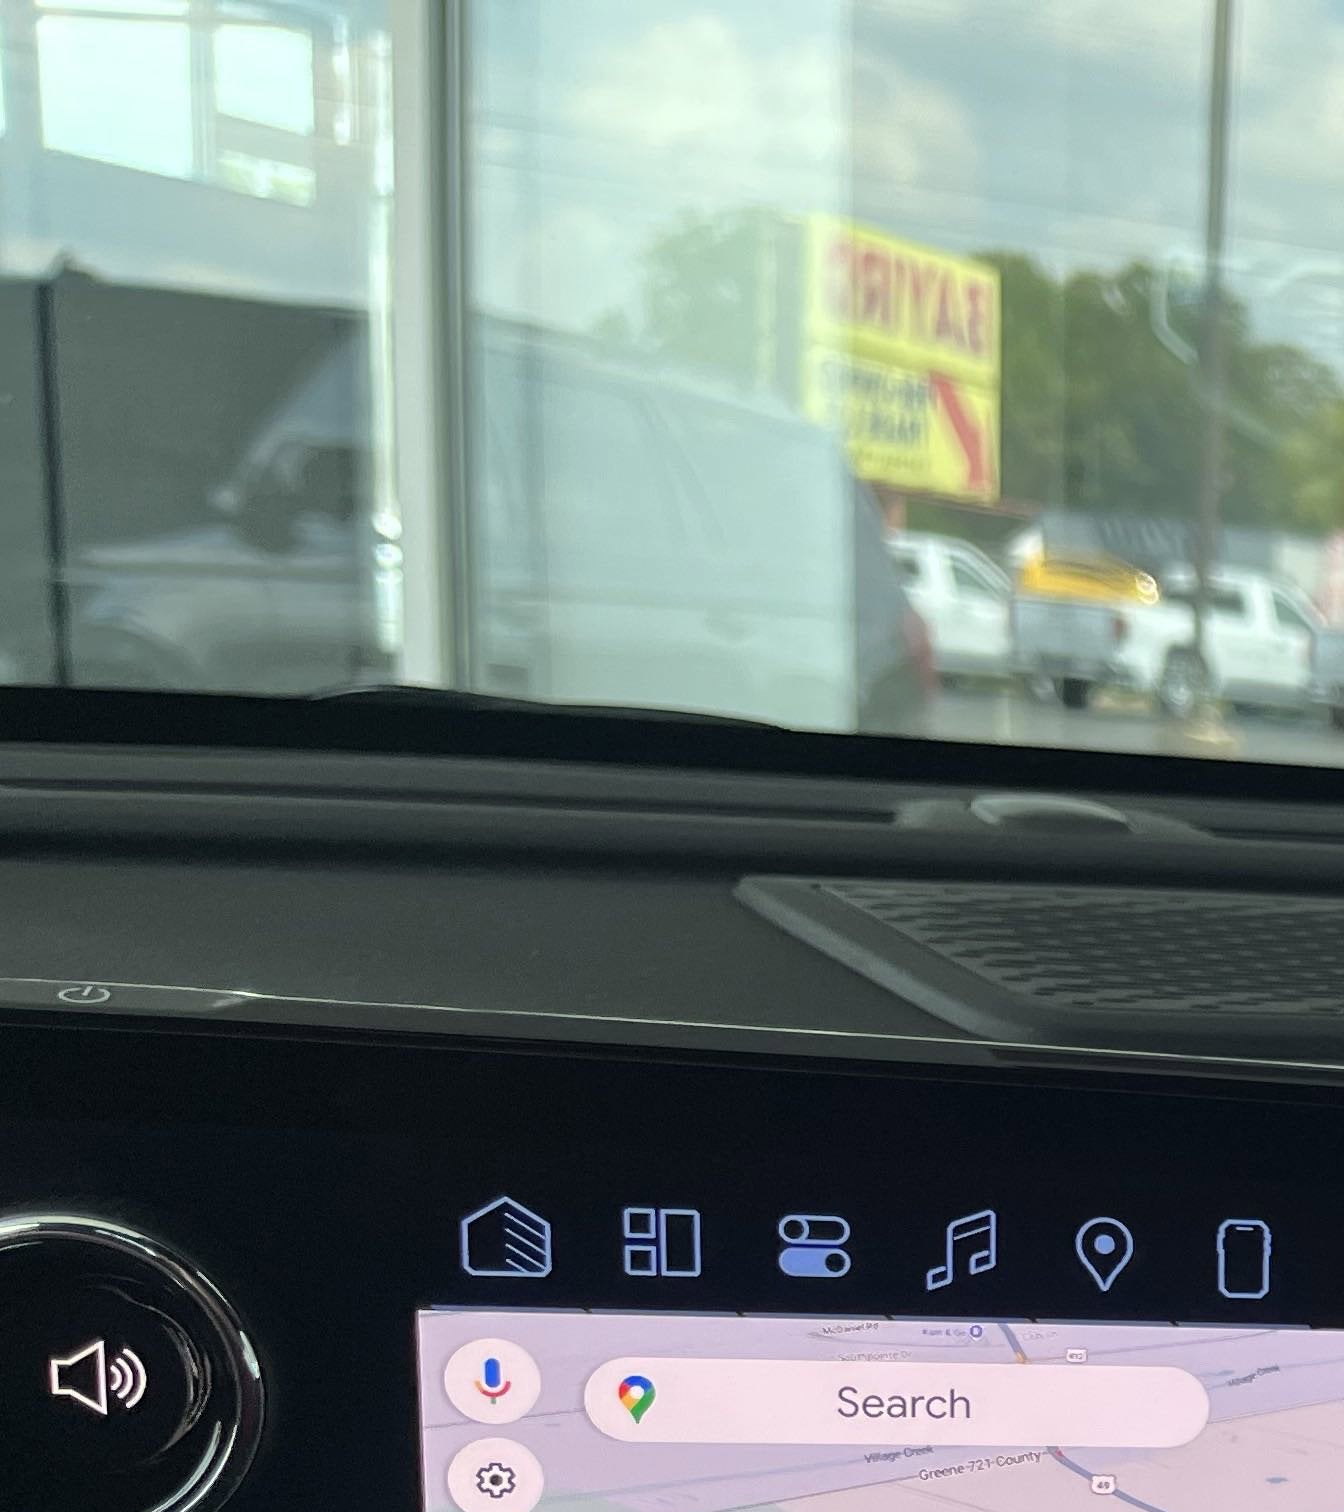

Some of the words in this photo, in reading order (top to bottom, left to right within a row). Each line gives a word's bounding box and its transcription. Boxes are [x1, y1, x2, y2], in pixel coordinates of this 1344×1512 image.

[837, 1386, 971, 1419] Search
[919, 1464, 964, 1481] Greene
[996, 1450, 1042, 1467] County
